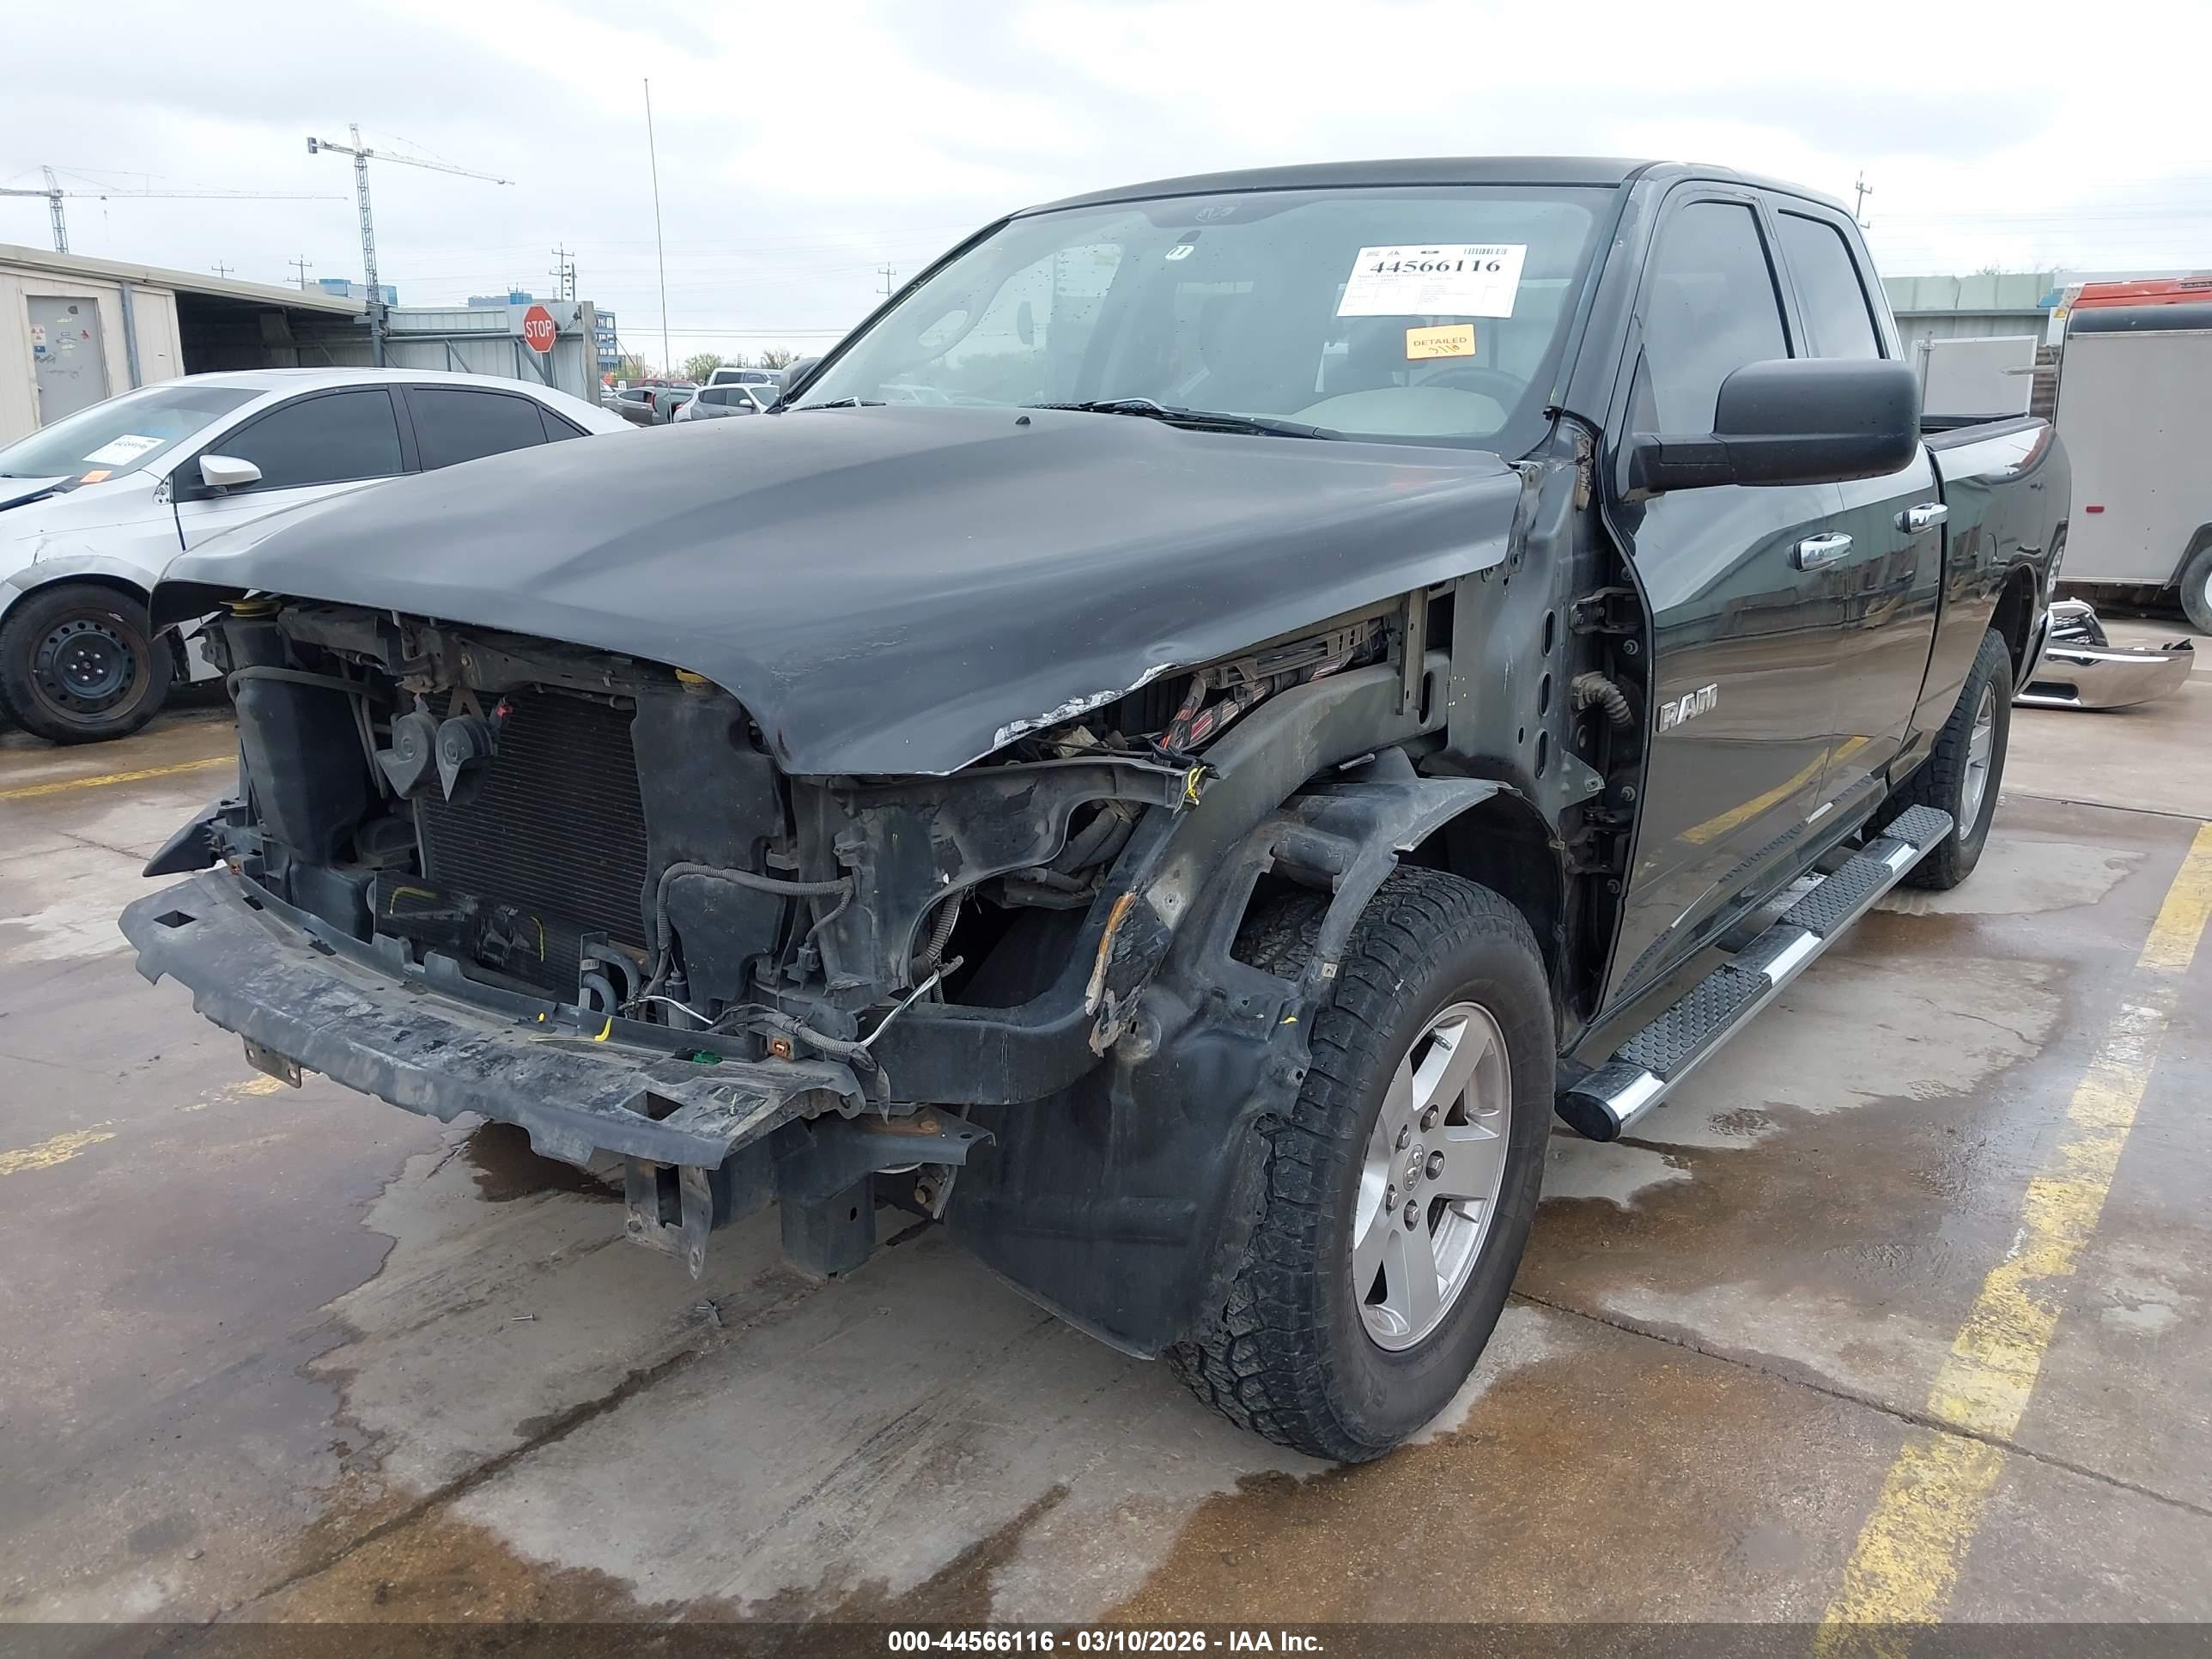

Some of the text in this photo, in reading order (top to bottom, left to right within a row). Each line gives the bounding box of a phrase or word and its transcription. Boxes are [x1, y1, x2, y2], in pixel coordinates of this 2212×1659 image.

[1370, 259, 1502, 273] 44566116
[526, 319, 552, 338] STOP
[1413, 336, 1468, 347] DETAILED
[1656, 683, 1717, 732] RAM
